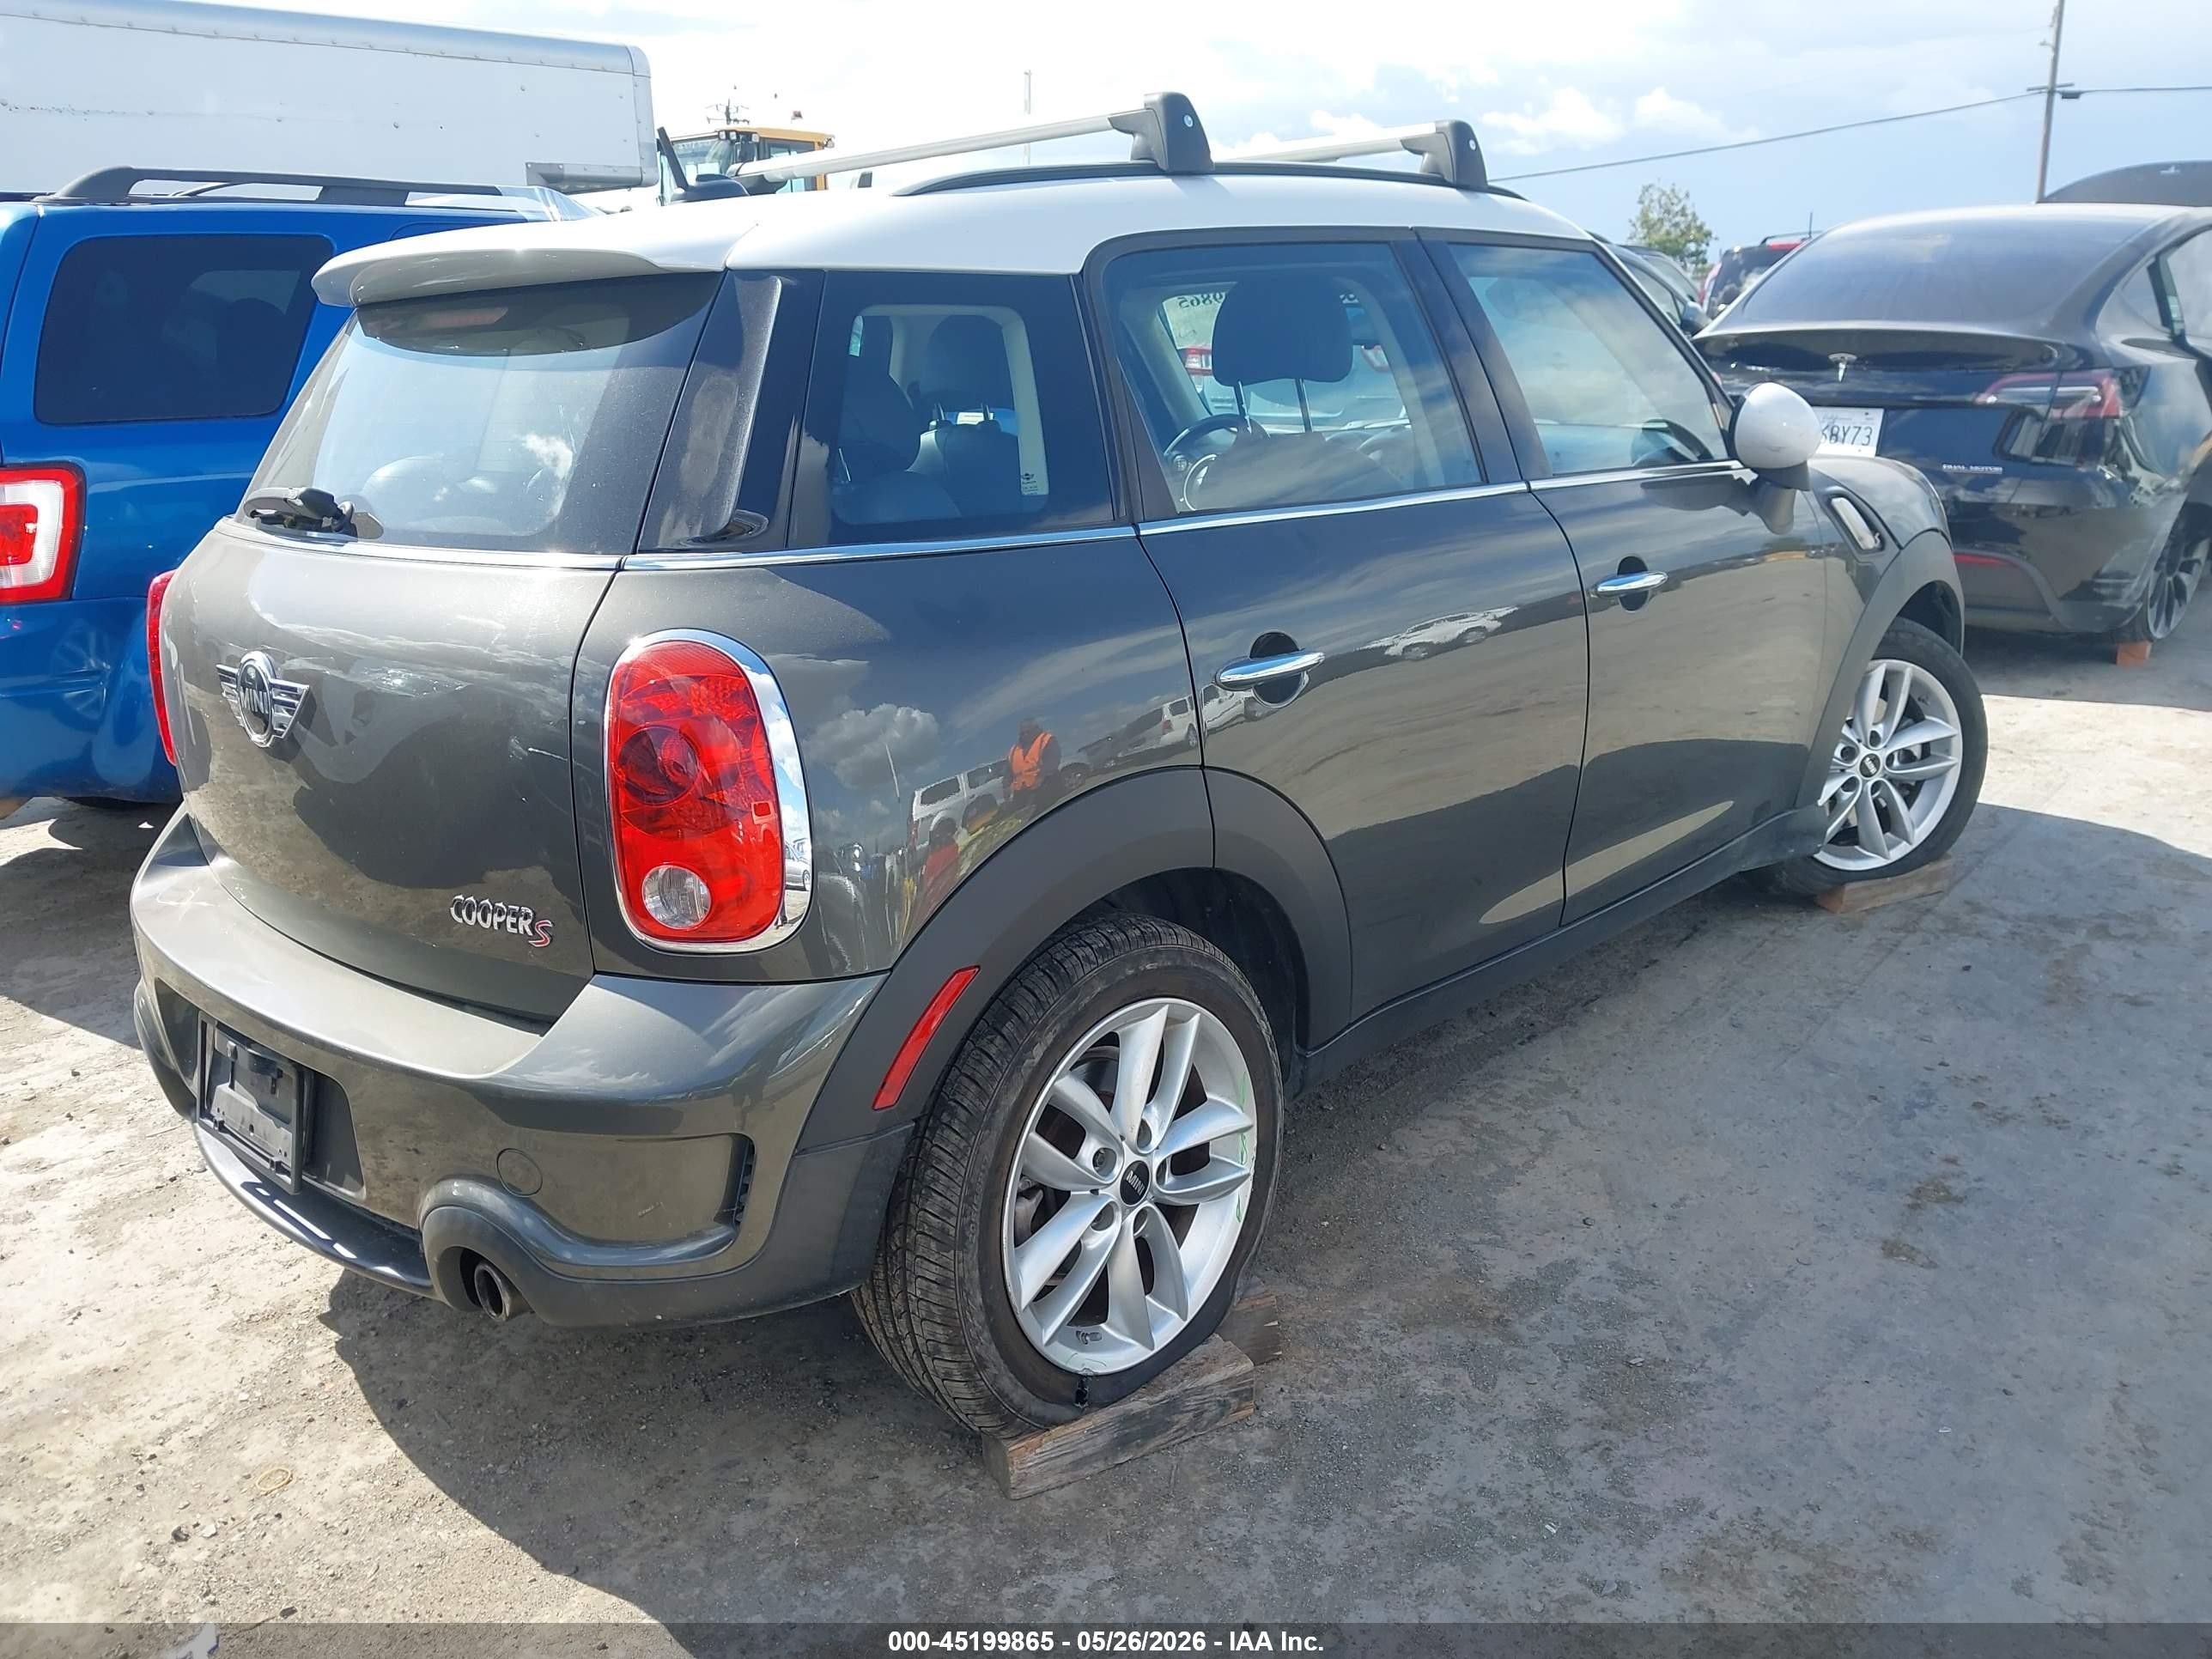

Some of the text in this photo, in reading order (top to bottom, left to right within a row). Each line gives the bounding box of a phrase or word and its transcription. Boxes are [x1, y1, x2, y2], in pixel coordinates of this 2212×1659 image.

[240, 685, 270, 714] MINI
[450, 894, 554, 947] COOPER S
[1126, 1170, 1146, 1196] MINI
